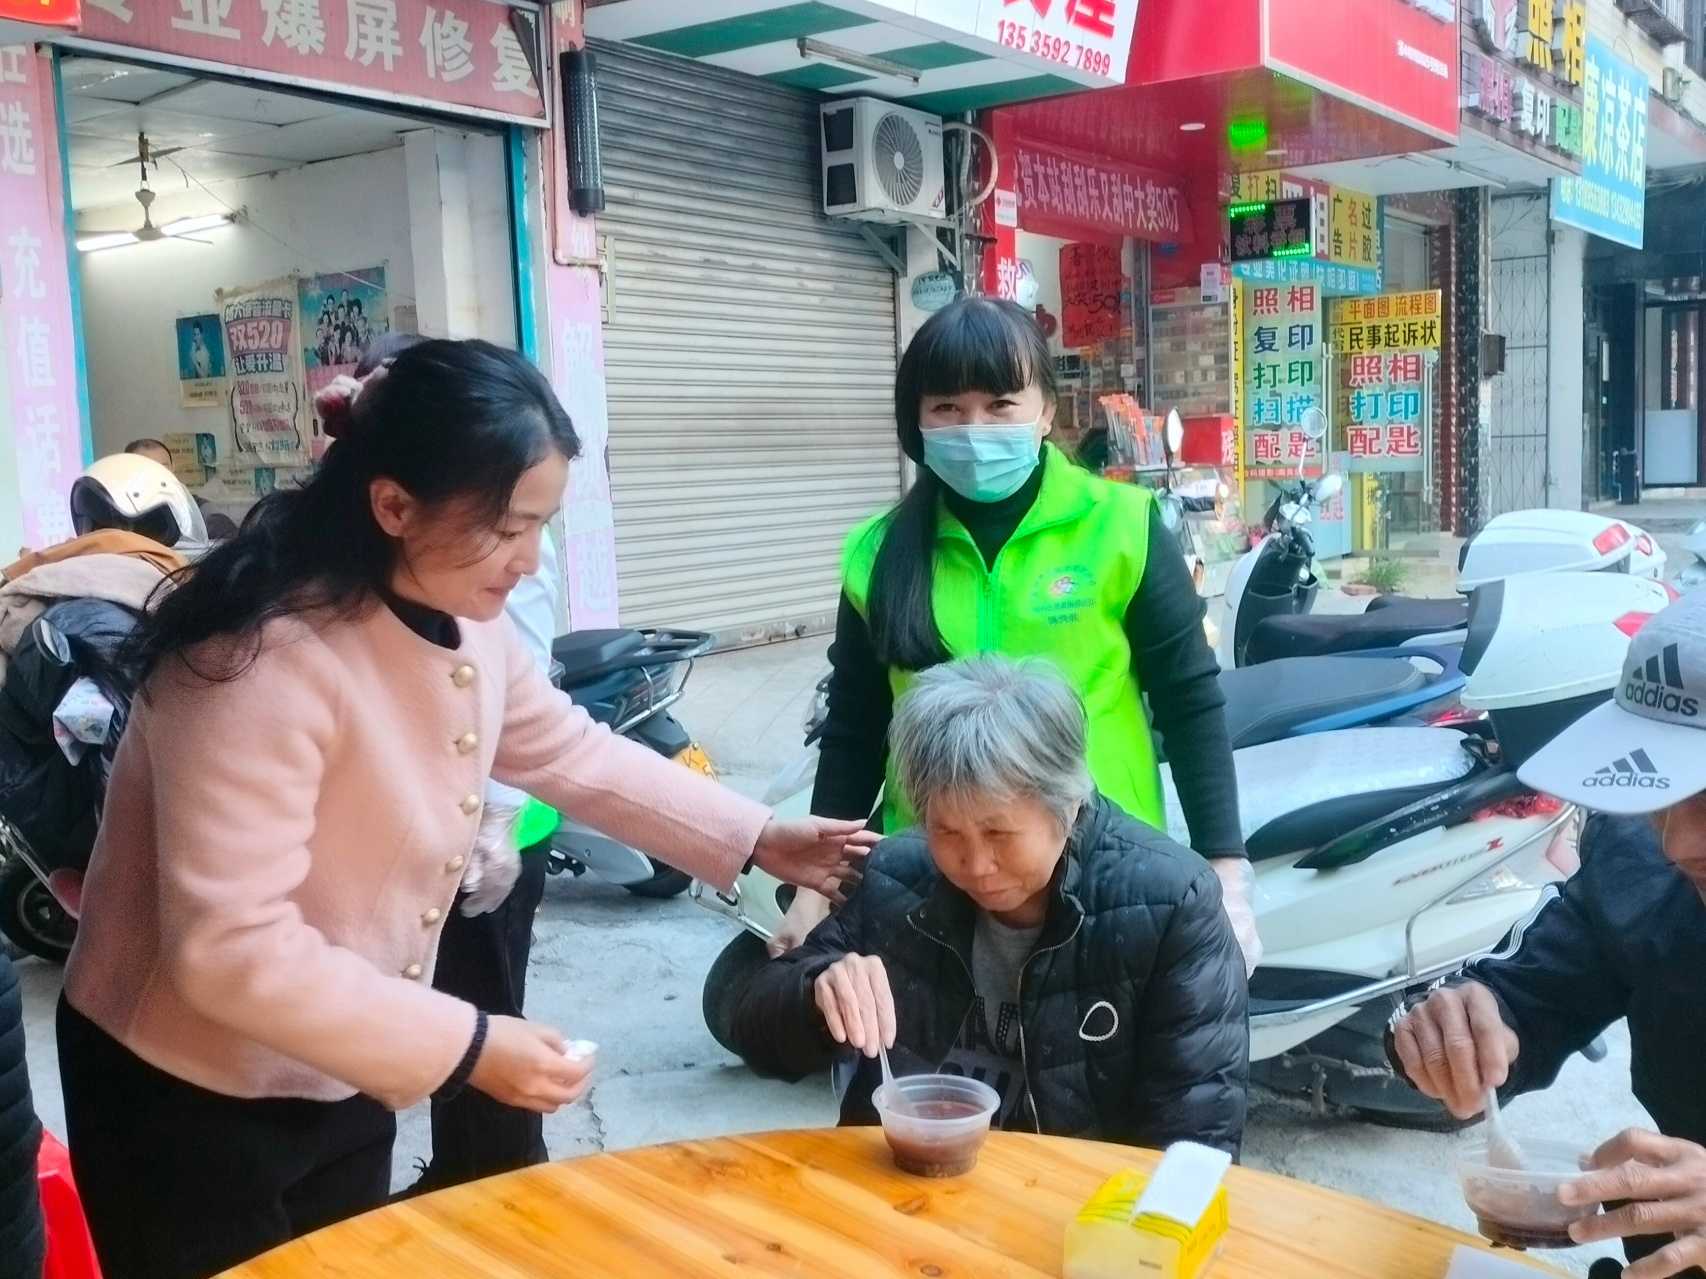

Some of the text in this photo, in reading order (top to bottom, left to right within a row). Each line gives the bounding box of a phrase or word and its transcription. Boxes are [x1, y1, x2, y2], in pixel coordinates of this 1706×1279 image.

[106, 0, 541, 98] 业爆屏修复
[997, 19, 1026, 49] 135
[1030, 30, 1071, 64] 3592
[1076, 45, 1111, 76] 7899
[1519, 77, 1550, 143] 复印
[1332, 193, 1343, 258] 广告
[1348, 197, 1358, 261] 名片
[1361, 201, 1372, 263] 过胶
[1252, 284, 1315, 316] 照相
[1349, 296, 1390, 319] 平面图
[1394, 292, 1437, 317] 流程图
[229, 320, 283, 351] 双520
[1253, 323, 1314, 354] 复印
[1349, 321, 1437, 350] 民事起诉状
[234, 353, 285, 376] 让爱升温
[1253, 359, 1313, 391] 打印
[1350, 353, 1422, 387] 照相
[1253, 394, 1315, 426] 扫描
[1351, 390, 1420, 421] 打印
[1253, 429, 1315, 460] 配匙
[1348, 425, 1422, 457] 配匙
[1625, 682, 1699, 717] addias
[1581, 772, 1671, 790] addias
